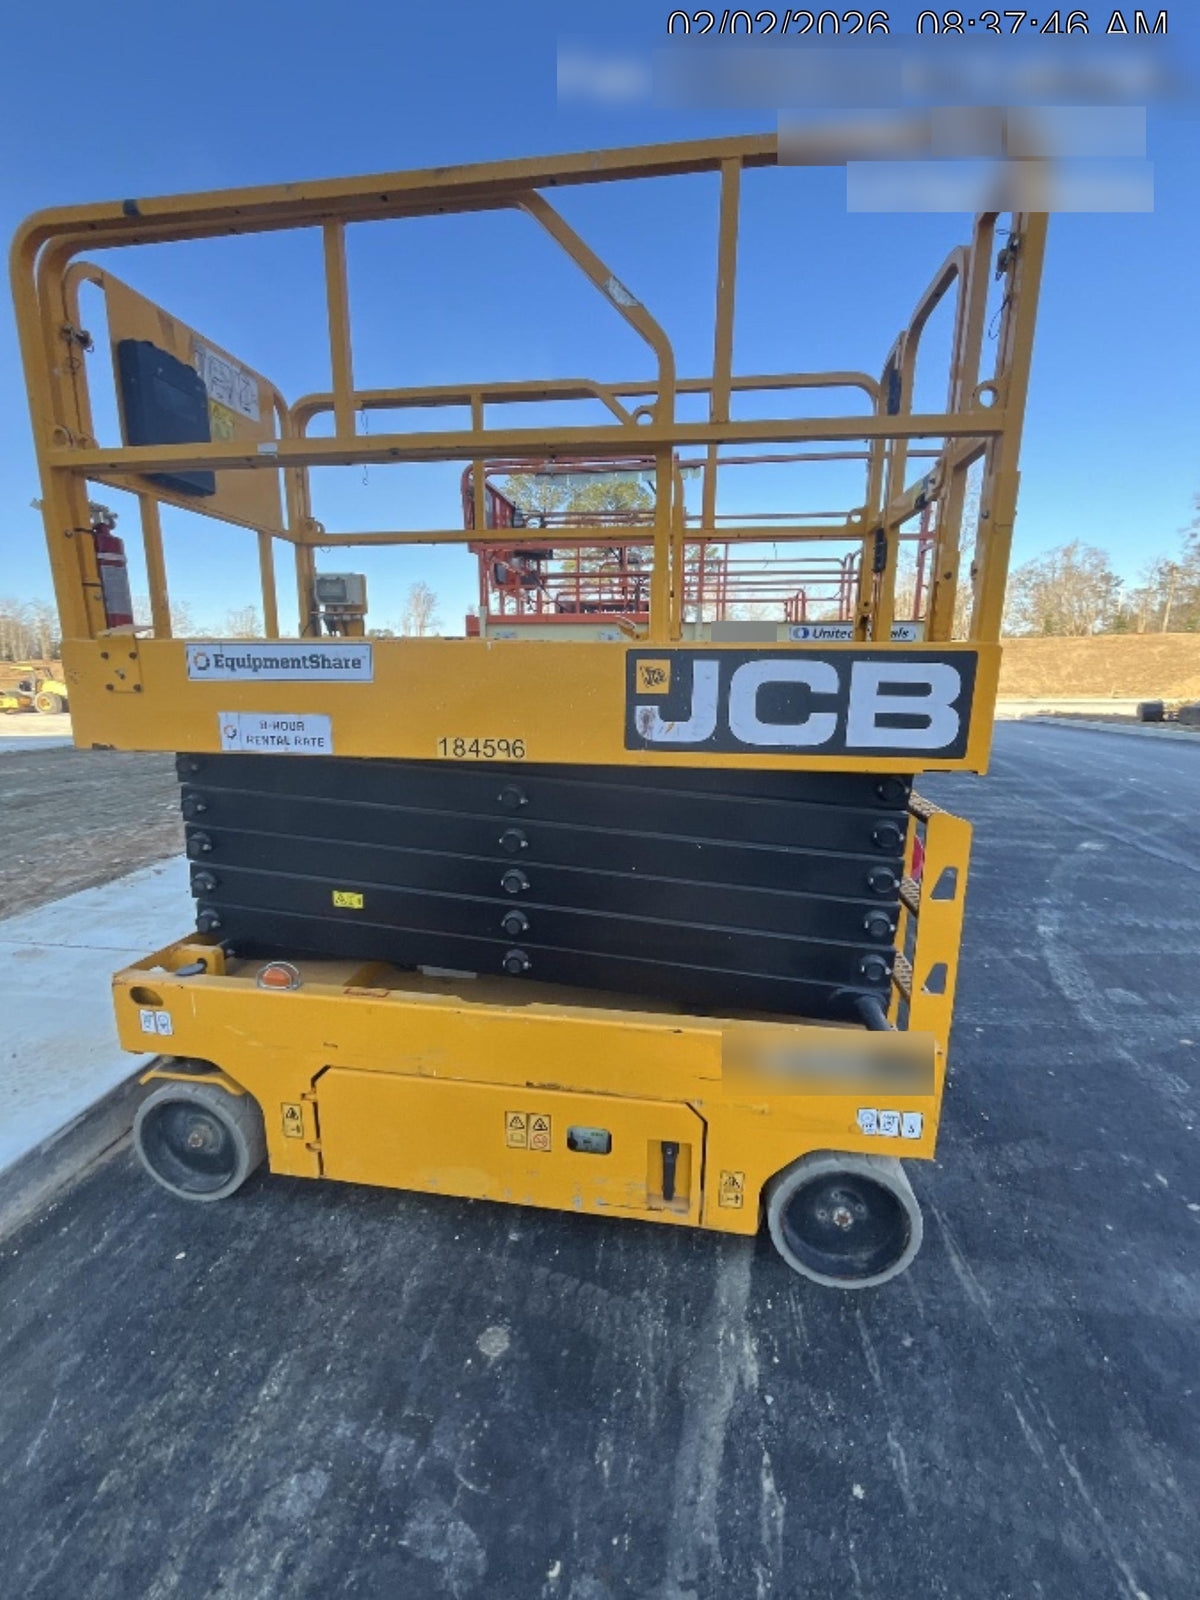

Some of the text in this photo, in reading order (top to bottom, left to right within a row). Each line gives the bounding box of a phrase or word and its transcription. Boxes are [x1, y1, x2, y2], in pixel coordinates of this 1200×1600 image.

[213, 653, 361, 672] EquipmentShare
[635, 659, 961, 749] JCB
[246, 735, 324, 748] RENTAL RATE
[439, 737, 525, 758] 184596
